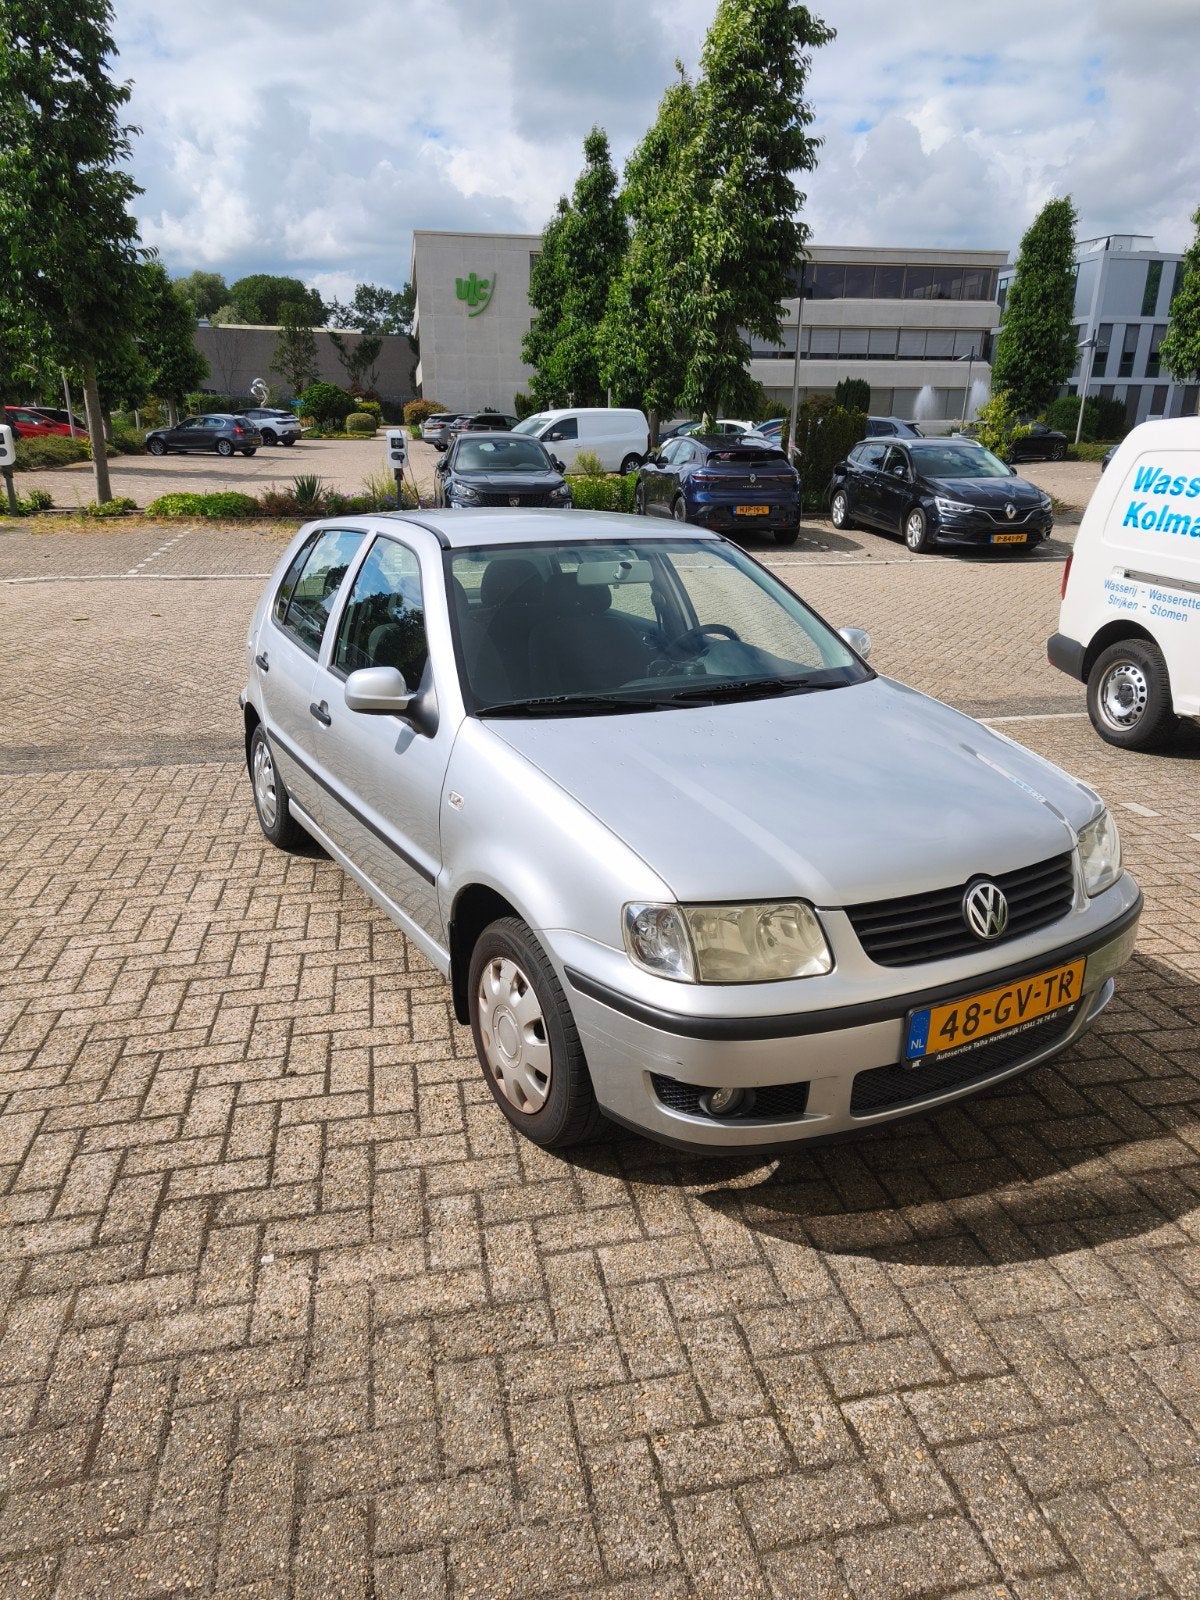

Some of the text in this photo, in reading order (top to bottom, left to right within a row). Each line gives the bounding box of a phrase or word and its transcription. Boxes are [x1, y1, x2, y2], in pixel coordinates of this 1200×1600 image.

[1104, 578, 1138, 598] Wasserij
[1149, 588, 1200, 611] Wasserette
[1107, 594, 1139, 611] Strijken
[1150, 604, 1189, 623] Stomen
[939, 969, 1075, 1042] 48-GV-TR
[910, 1038, 925, 1050] NL
